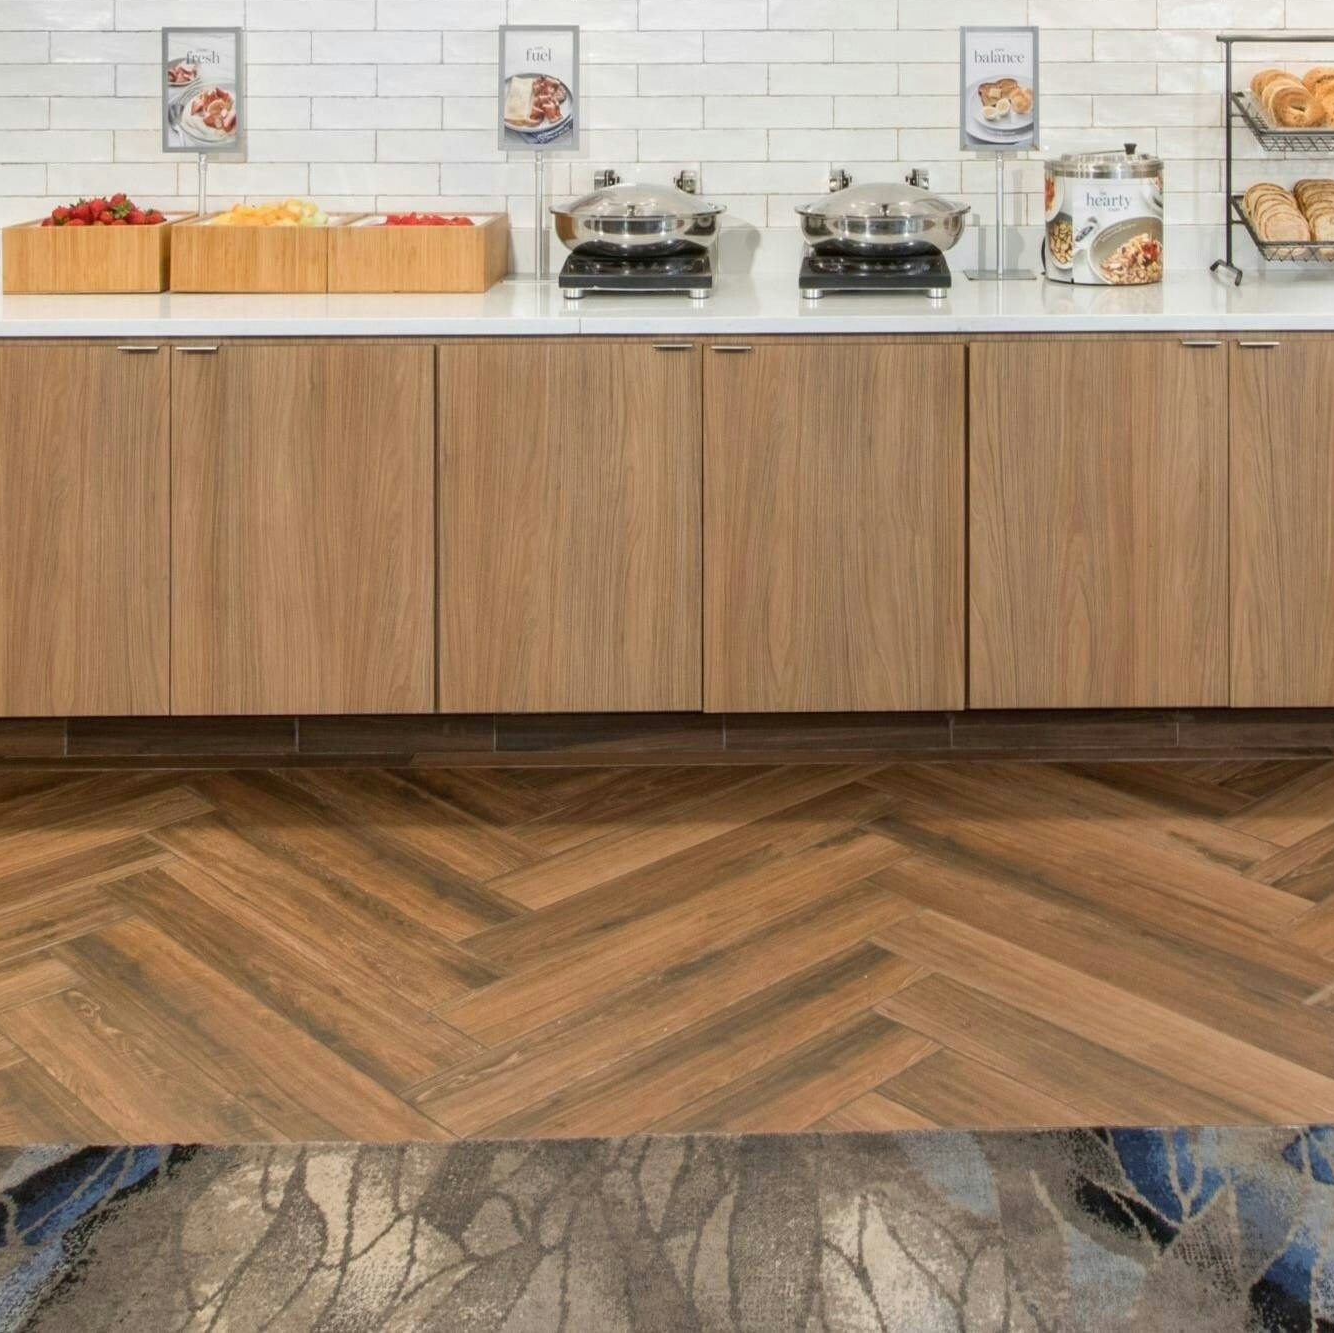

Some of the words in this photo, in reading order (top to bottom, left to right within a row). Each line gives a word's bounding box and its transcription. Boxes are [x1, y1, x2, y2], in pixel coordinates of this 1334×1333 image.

[186, 49, 220, 65] fresh
[526, 48, 552, 62] fuel
[974, 49, 1025, 64] balance
[1086, 192, 1132, 209] hearty
